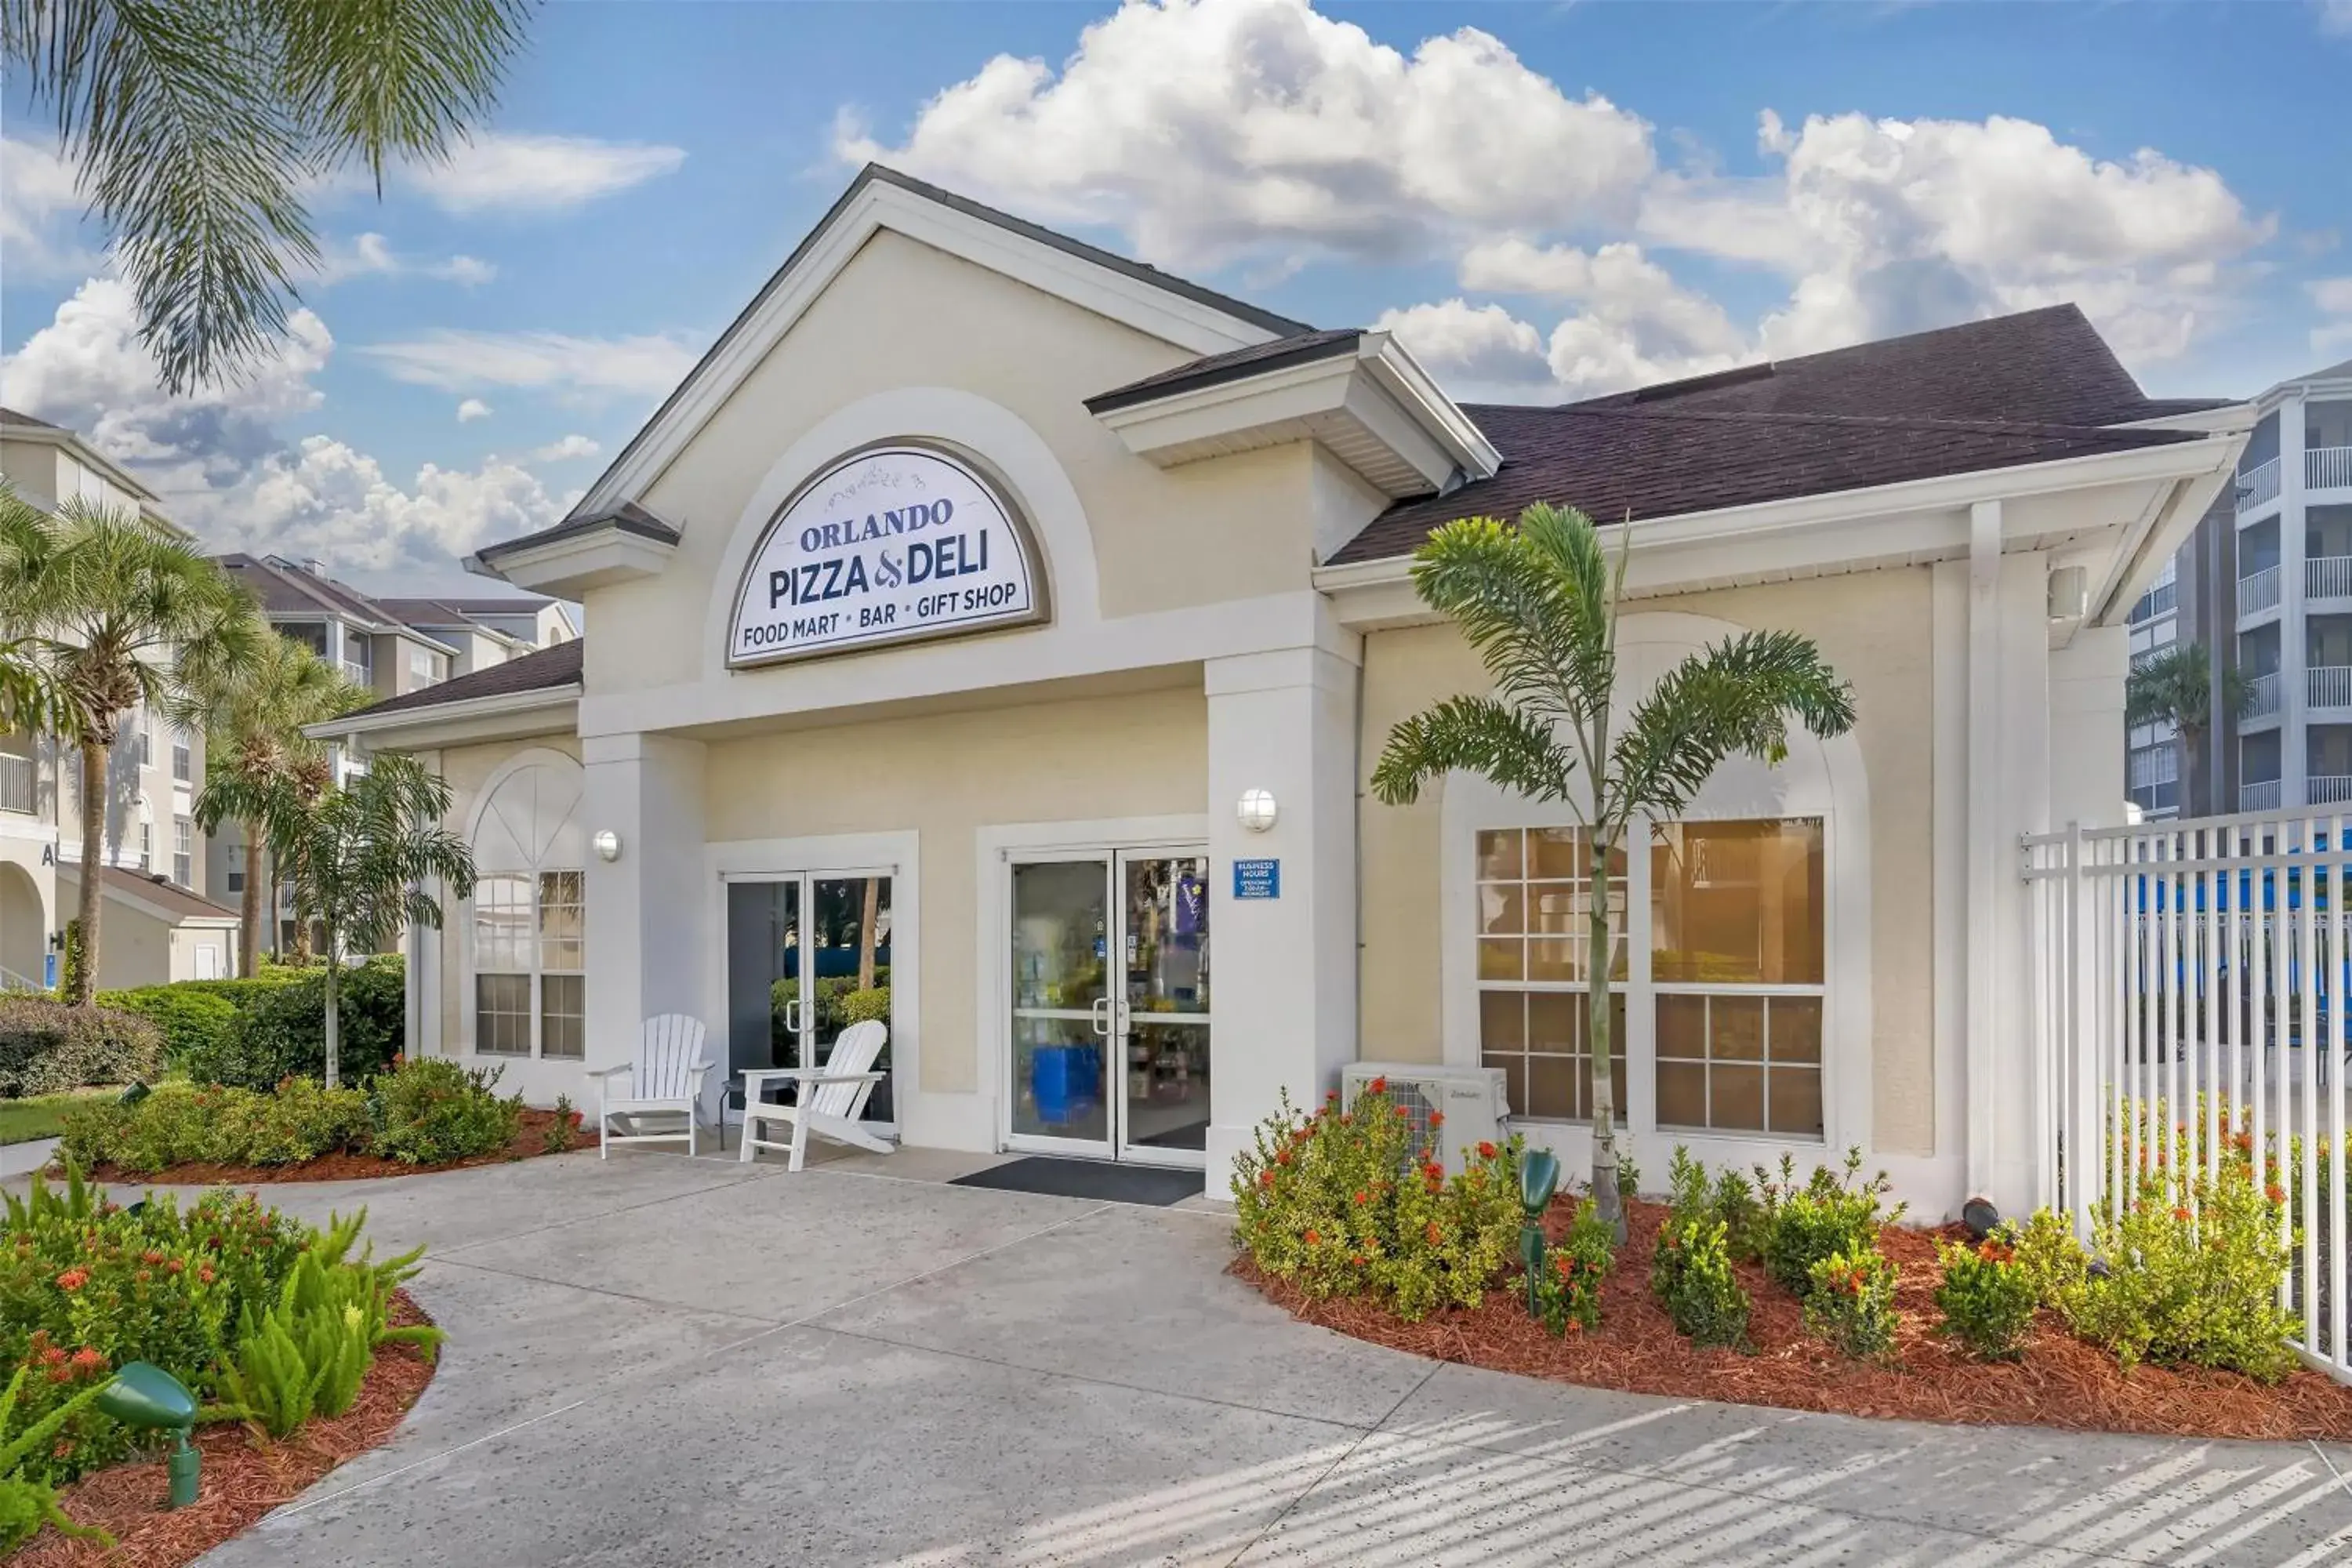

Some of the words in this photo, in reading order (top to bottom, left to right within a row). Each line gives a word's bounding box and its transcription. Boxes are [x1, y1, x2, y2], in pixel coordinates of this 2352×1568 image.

[800, 498, 954, 553] ORLANDO
[769, 554, 869, 609] PIZZA
[874, 549, 903, 589] &
[907, 528, 988, 585] DELI
[744, 622, 789, 648] FOOD
[793, 612, 840, 639] MART
[859, 603, 896, 628] BAR
[916, 592, 960, 617] GIFT
[964, 582, 1017, 611] SHOP
[42, 844, 54, 866] A
